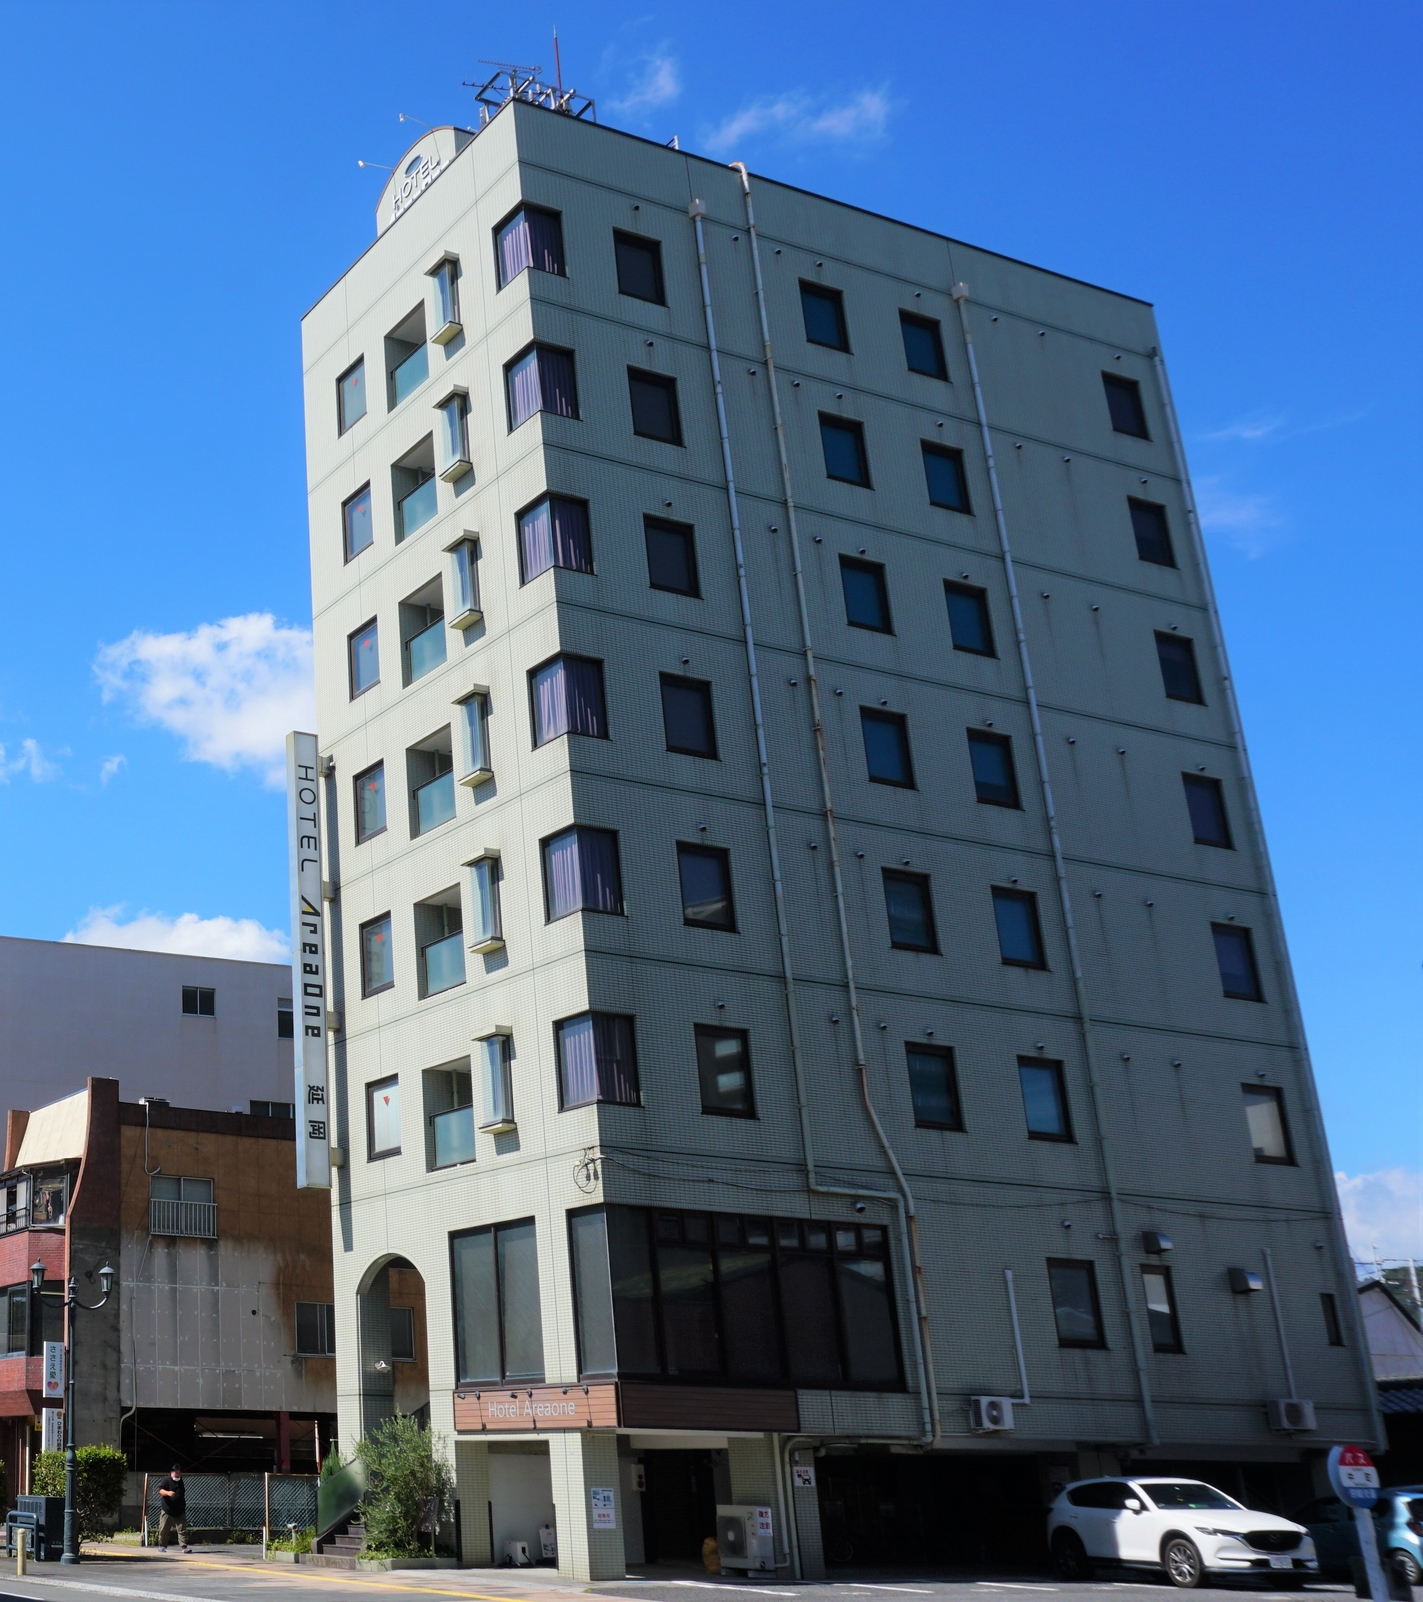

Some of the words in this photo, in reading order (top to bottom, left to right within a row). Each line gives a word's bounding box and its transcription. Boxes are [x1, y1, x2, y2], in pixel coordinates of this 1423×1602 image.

[392, 155, 441, 211] HOTEL
[297, 765, 319, 873] HOTEL
[307, 1083, 326, 1141] 延岡
[49, 1345, 57, 1379] ささえ愛
[487, 1401, 520, 1419] Hotel
[523, 1399, 576, 1417] Areaone
[1344, 1452, 1367, 1464] バス
